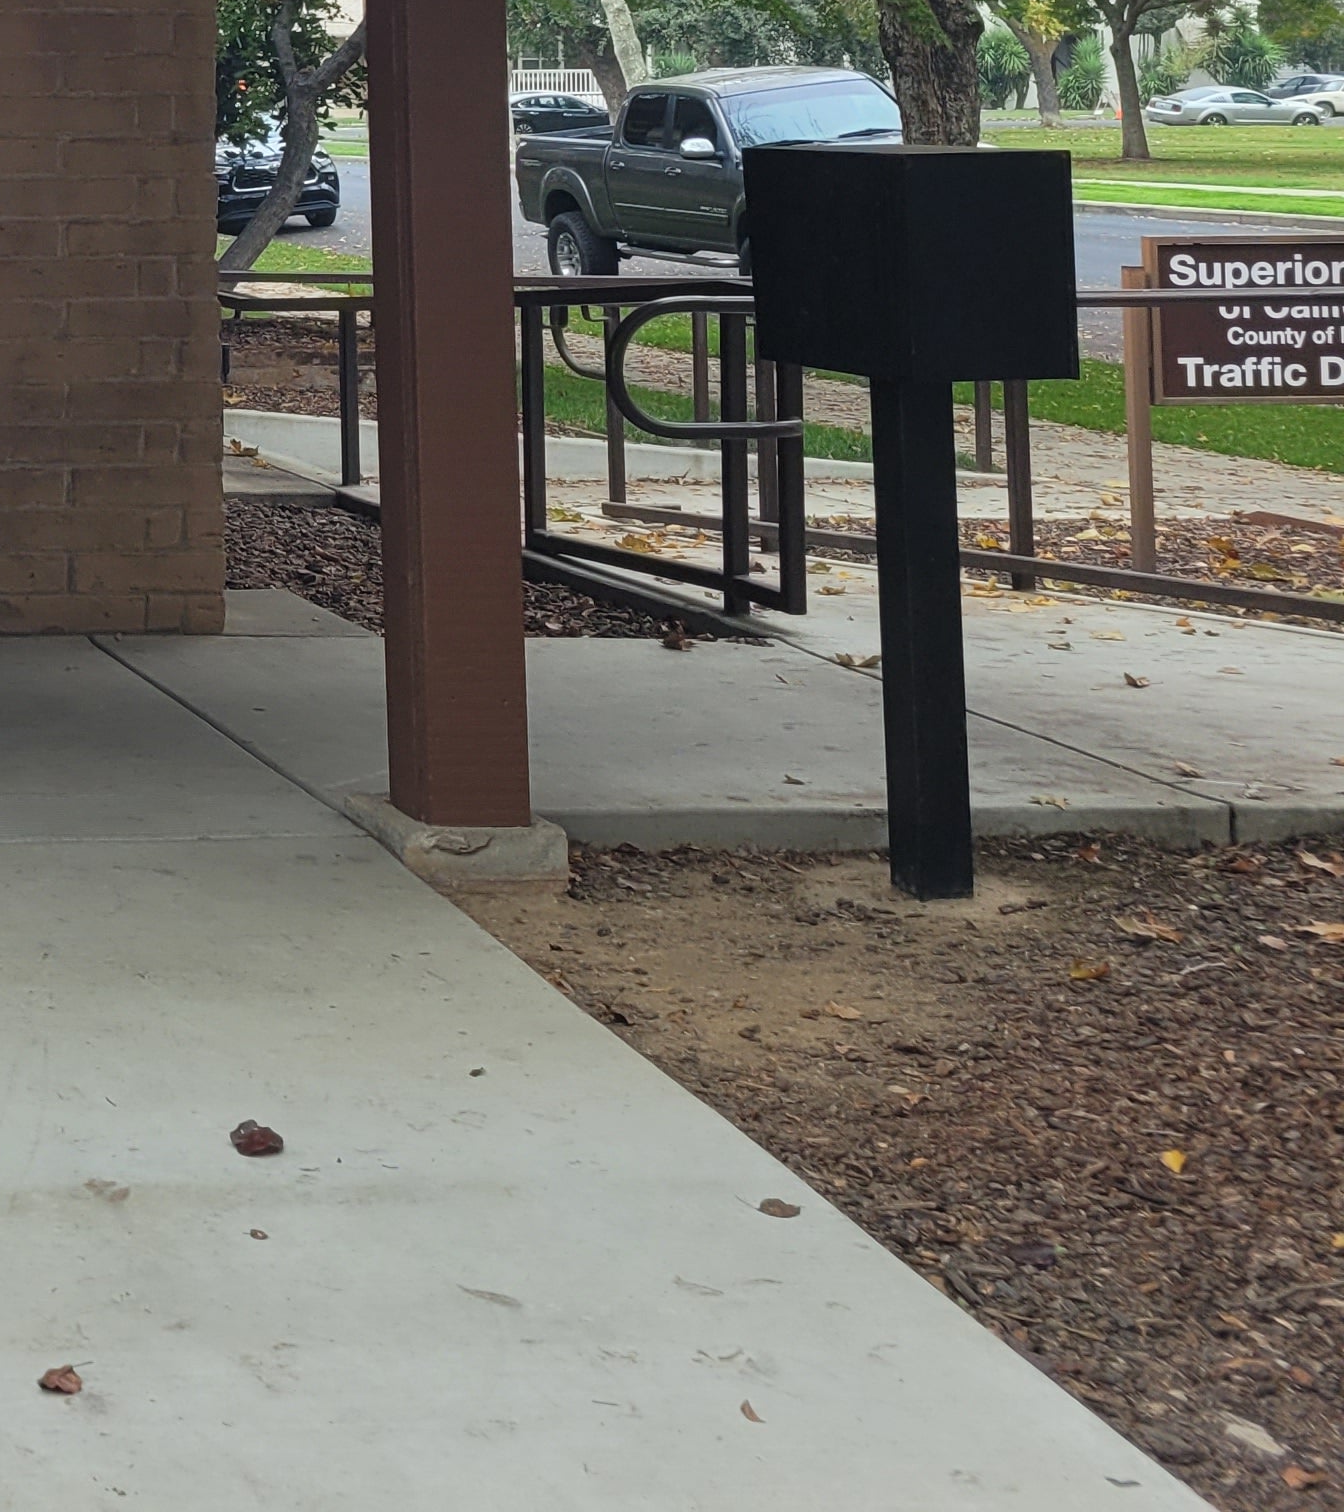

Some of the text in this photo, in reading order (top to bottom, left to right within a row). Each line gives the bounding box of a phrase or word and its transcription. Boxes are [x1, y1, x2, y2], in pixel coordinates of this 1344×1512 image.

[1169, 253, 1344, 290] Superior
[1226, 326, 1334, 348] County of
[1177, 356, 1307, 387] Traffic
